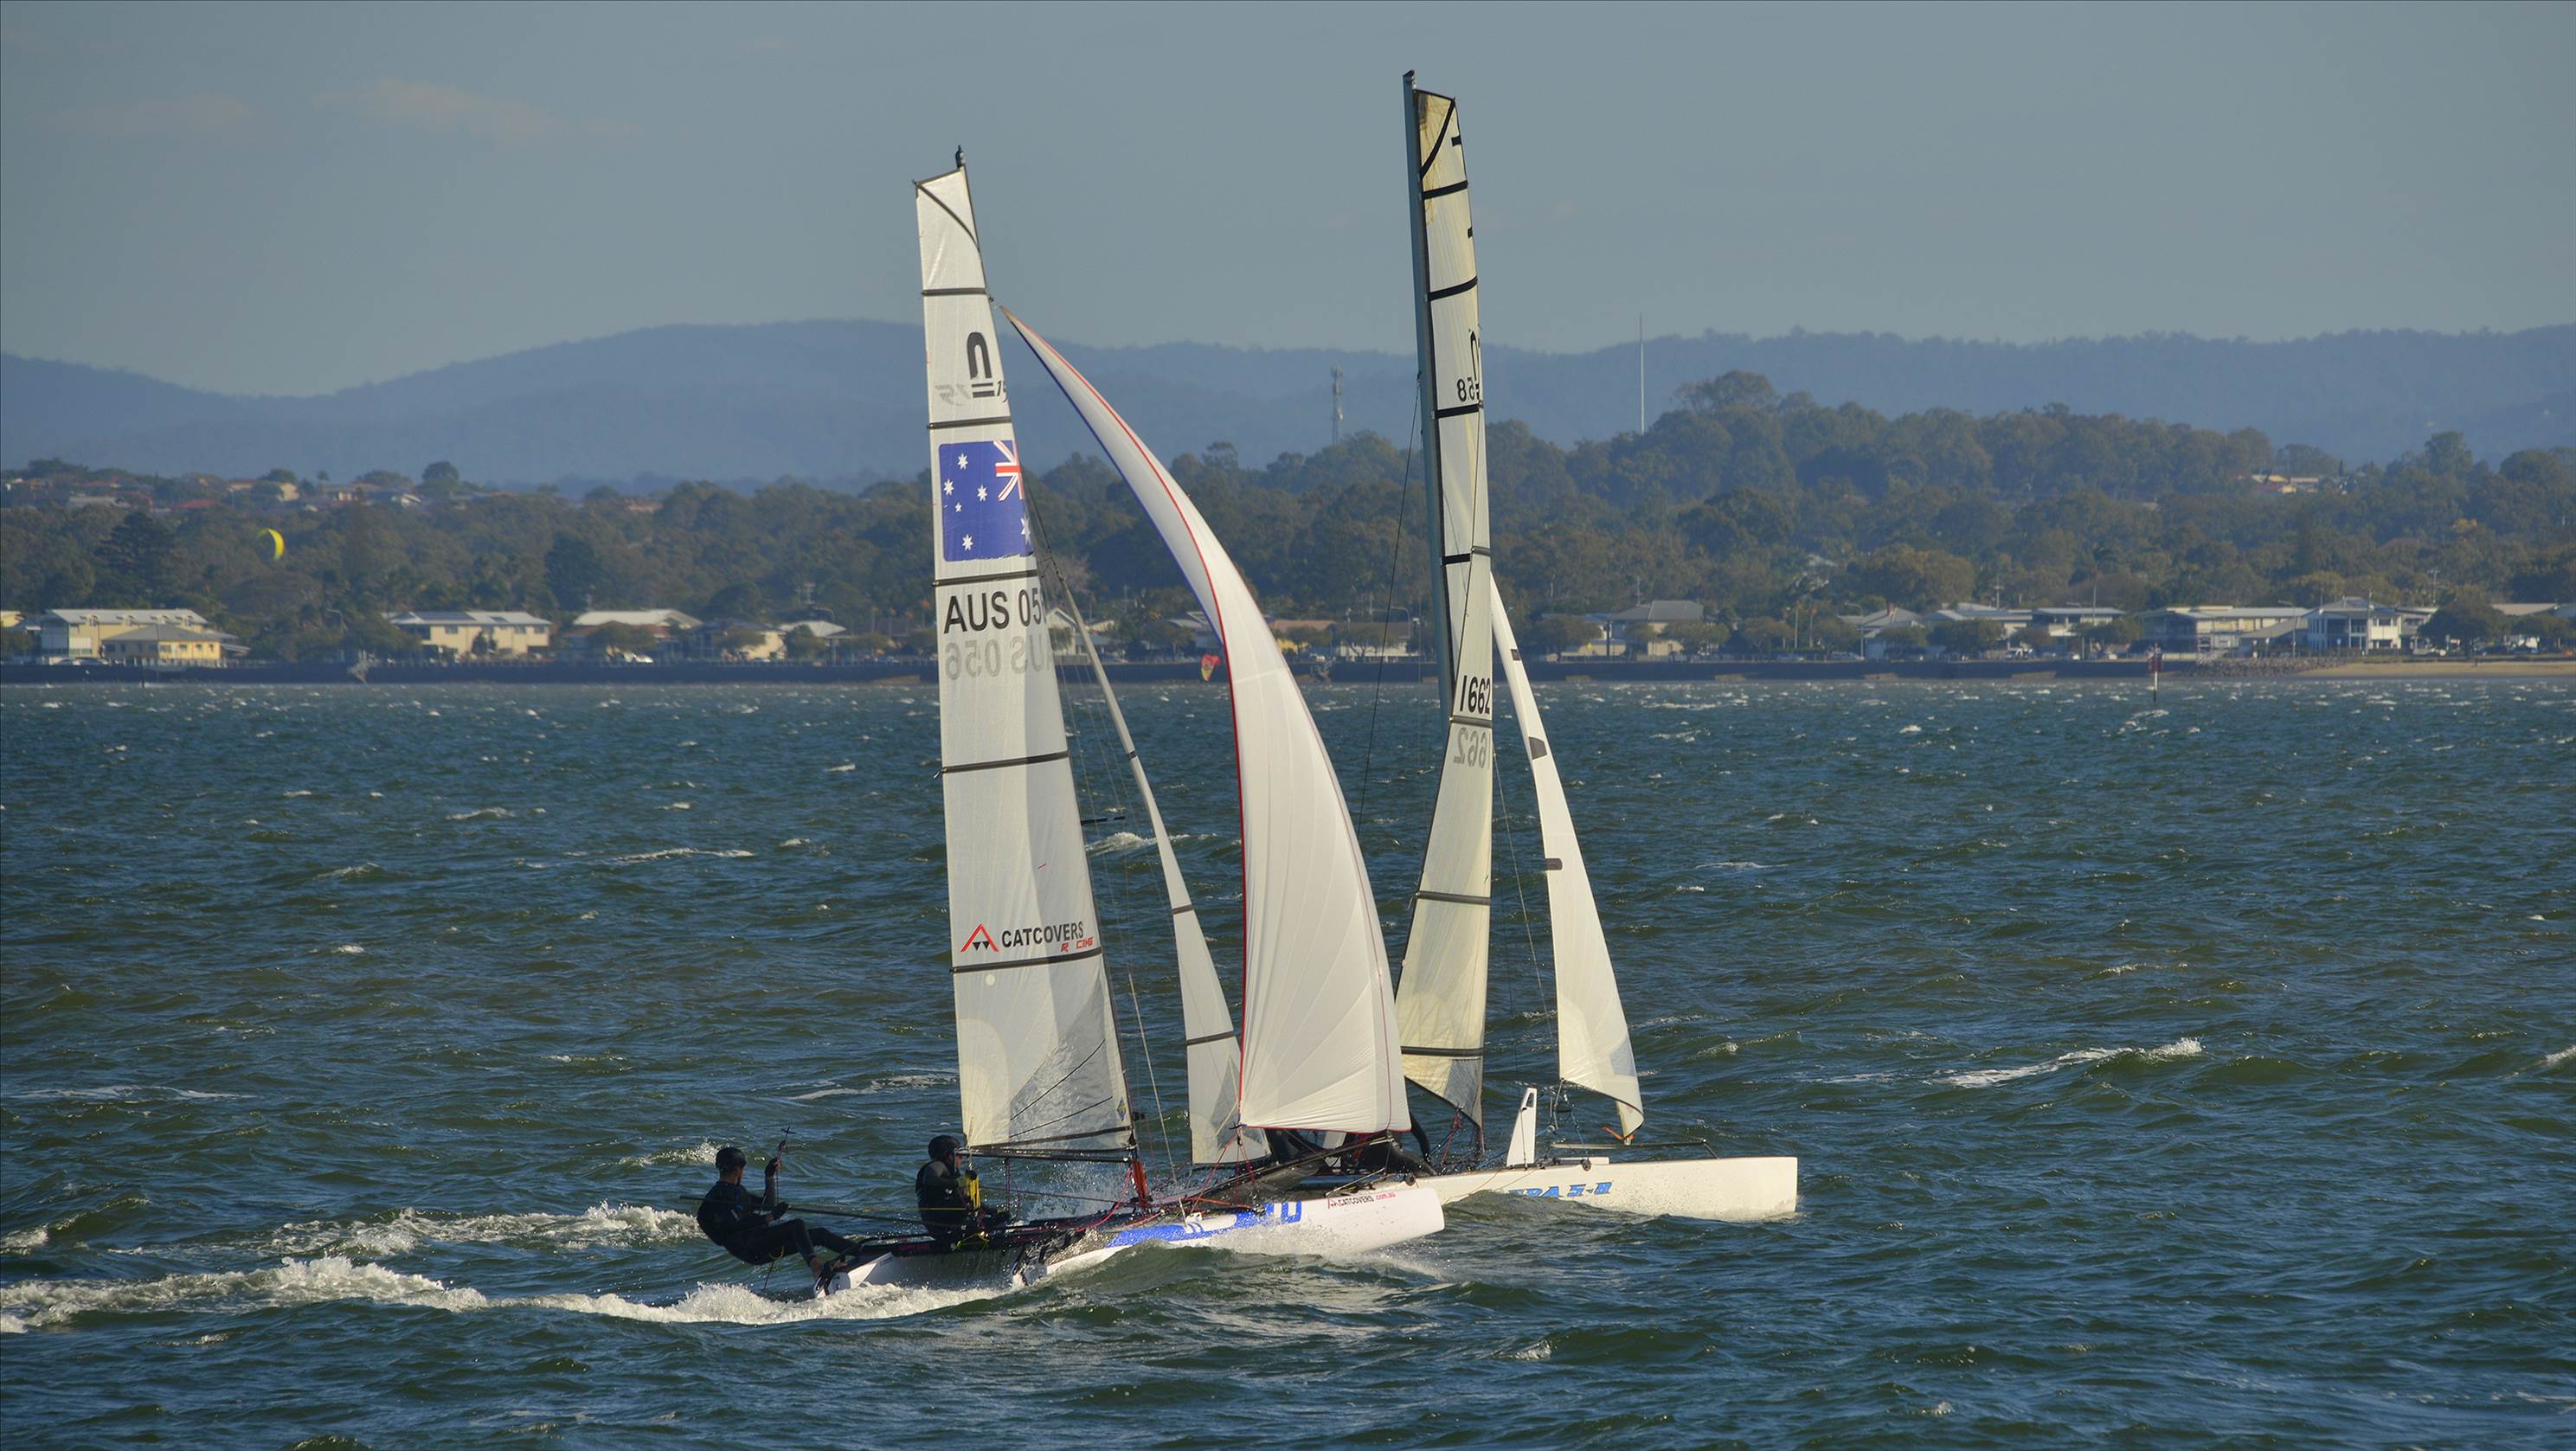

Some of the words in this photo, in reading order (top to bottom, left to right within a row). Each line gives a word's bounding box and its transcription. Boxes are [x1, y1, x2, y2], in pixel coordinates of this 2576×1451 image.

[943, 591, 1010, 634] AUS
[1018, 587, 1046, 626] 05
[1459, 675, 1491, 715] 1662
[1002, 921, 1083, 947] CATCOVERS
